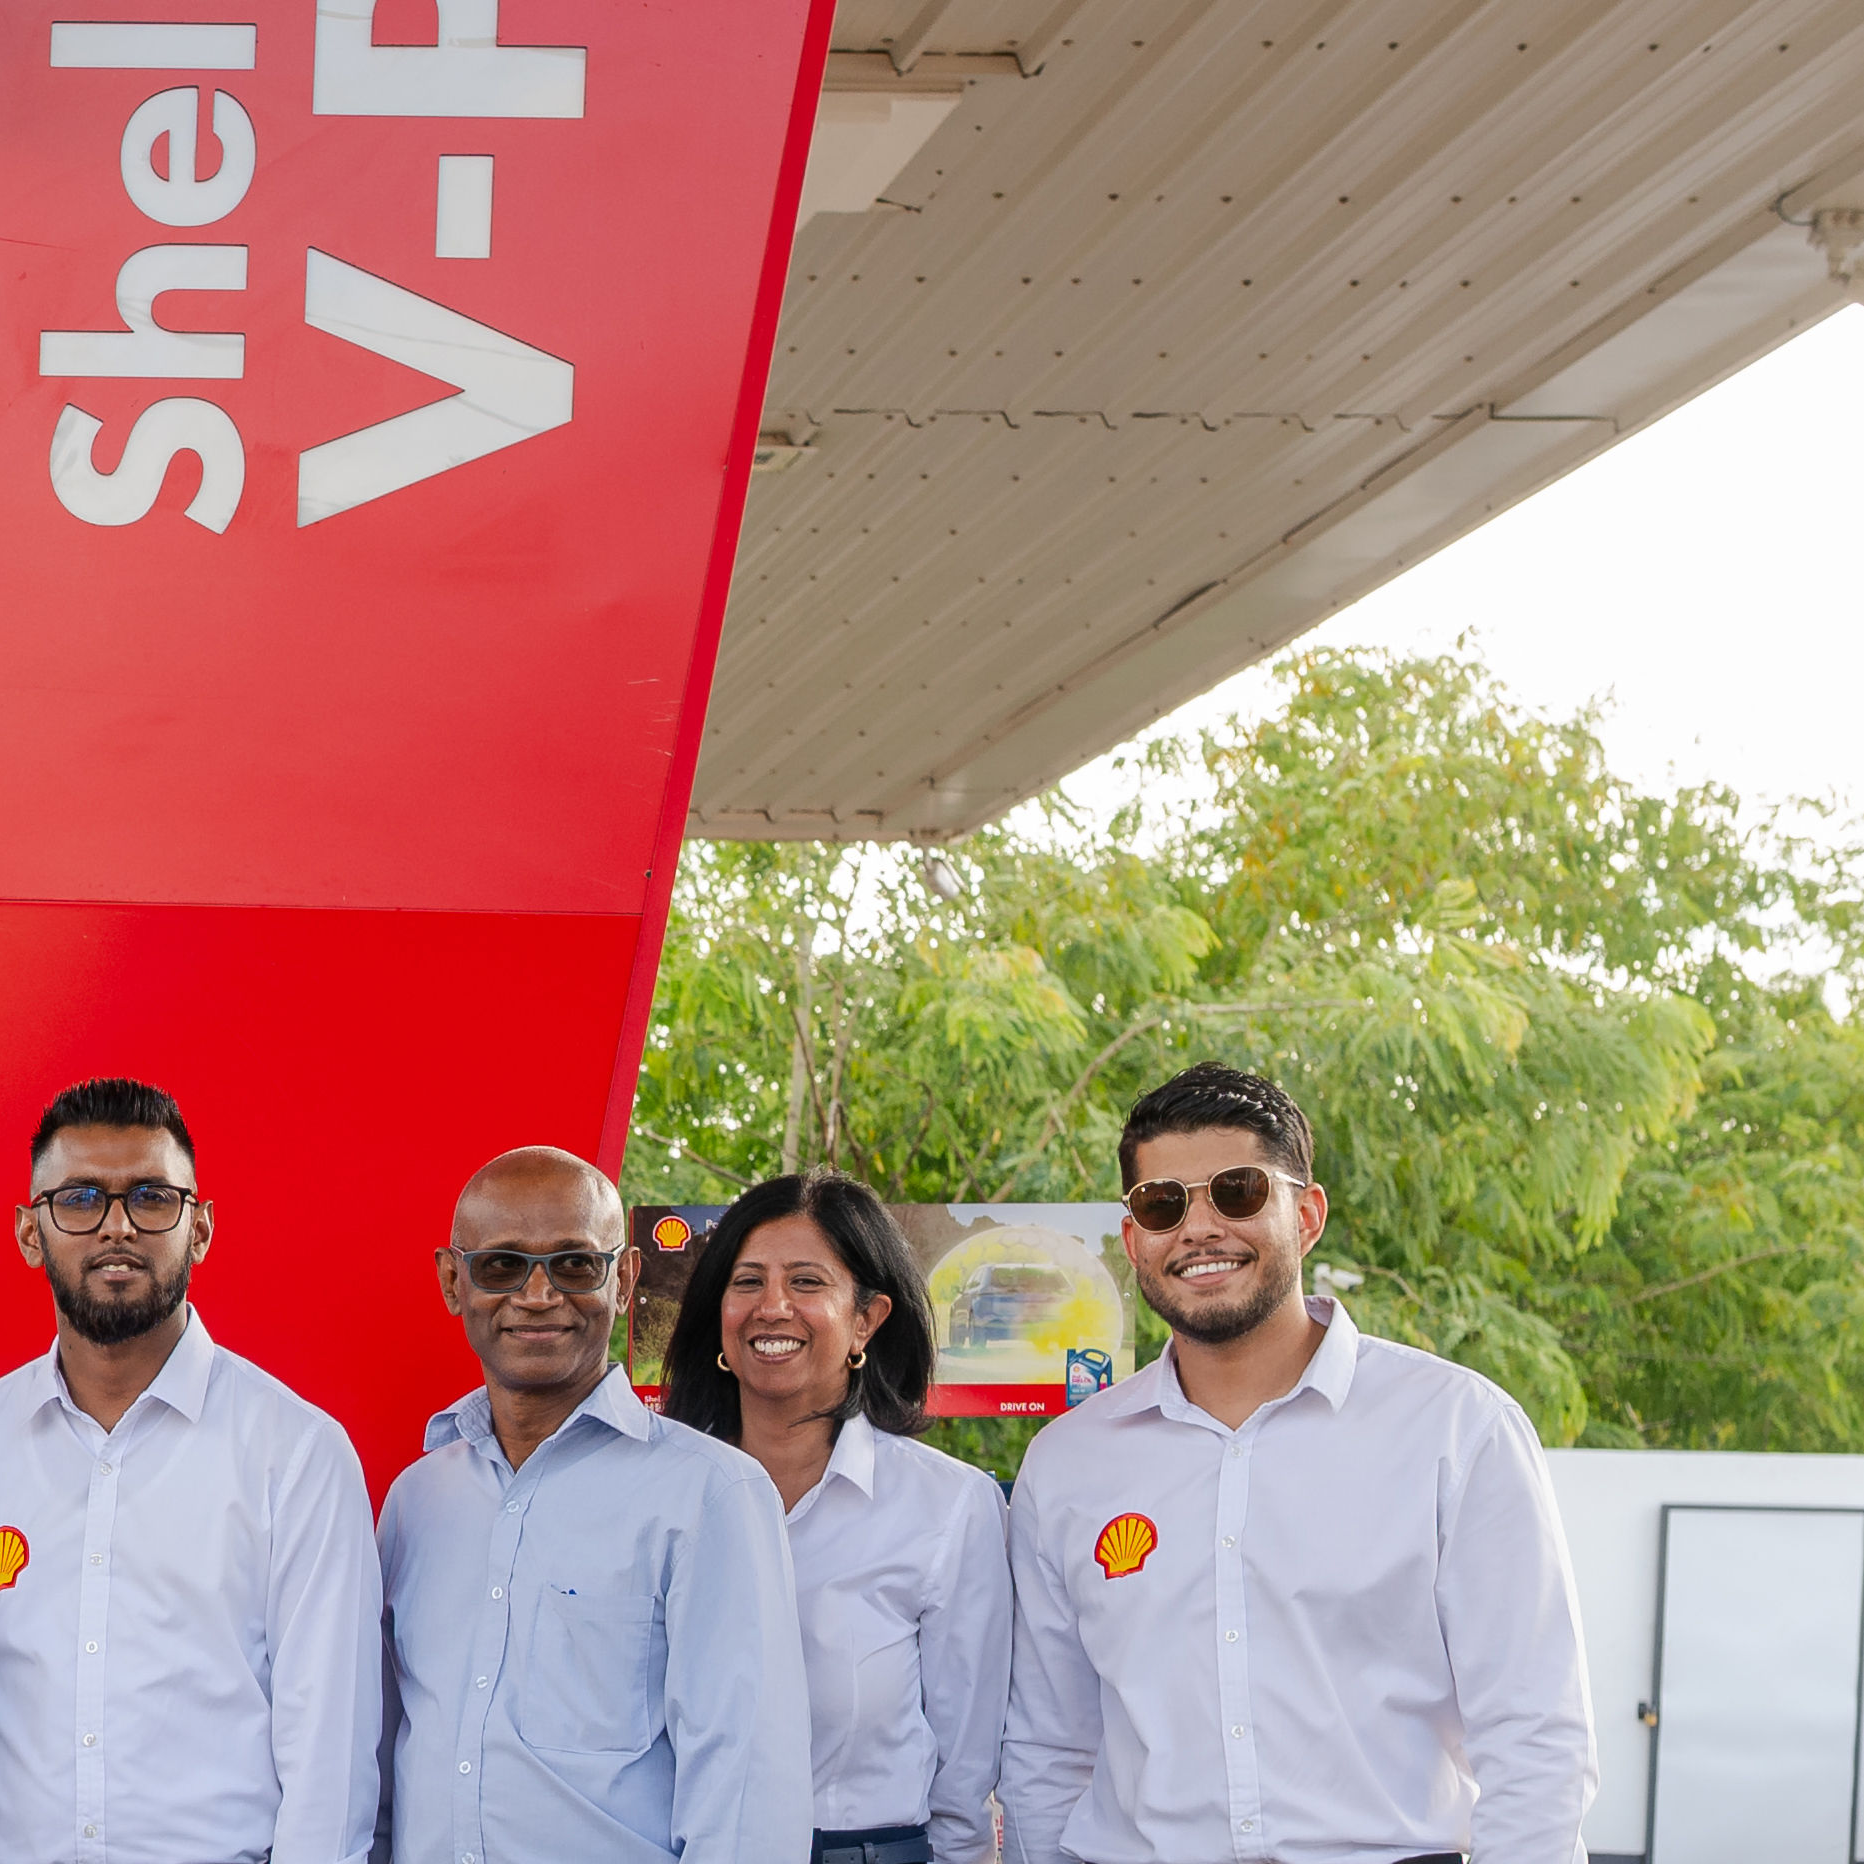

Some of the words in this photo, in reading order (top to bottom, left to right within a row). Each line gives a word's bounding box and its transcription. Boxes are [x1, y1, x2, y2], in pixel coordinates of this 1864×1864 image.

[38, 21, 257, 535] Shel
[1000, 1402, 1027, 1411] DRIVE
[1029, 1402, 1045, 1411] ON
